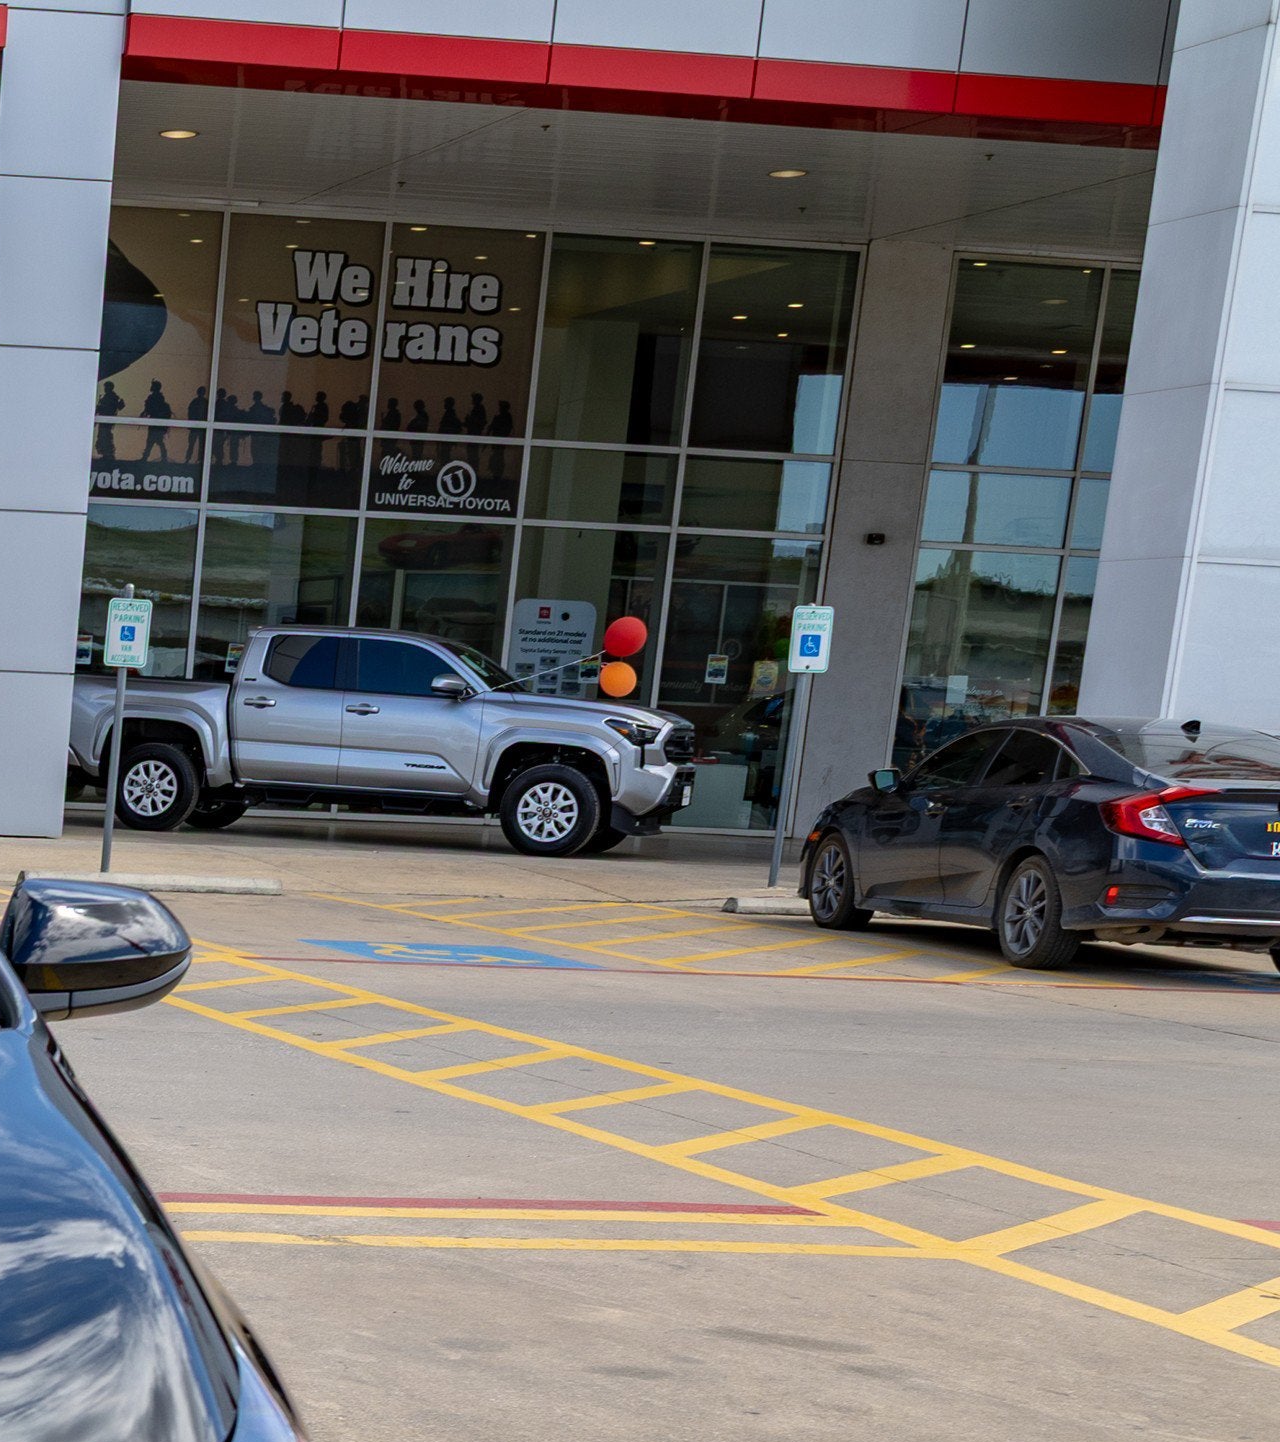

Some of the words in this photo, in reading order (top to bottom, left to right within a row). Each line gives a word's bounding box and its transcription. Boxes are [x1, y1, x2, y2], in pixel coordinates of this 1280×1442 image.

[292, 249, 374, 304] We
[391, 256, 502, 313] Hire
[255, 301, 503, 366] Veterans
[379, 452, 435, 476] Welcome
[398, 473, 416, 491] to
[374, 492, 454, 509] UNIVERSAL
[458, 497, 511, 512] TOYOTA
[113, 602, 149, 613] RESERVED
[114, 614, 145, 624] PARKING
[797, 623, 827, 632] PARKING
[403, 762, 447, 770] TACOMA
